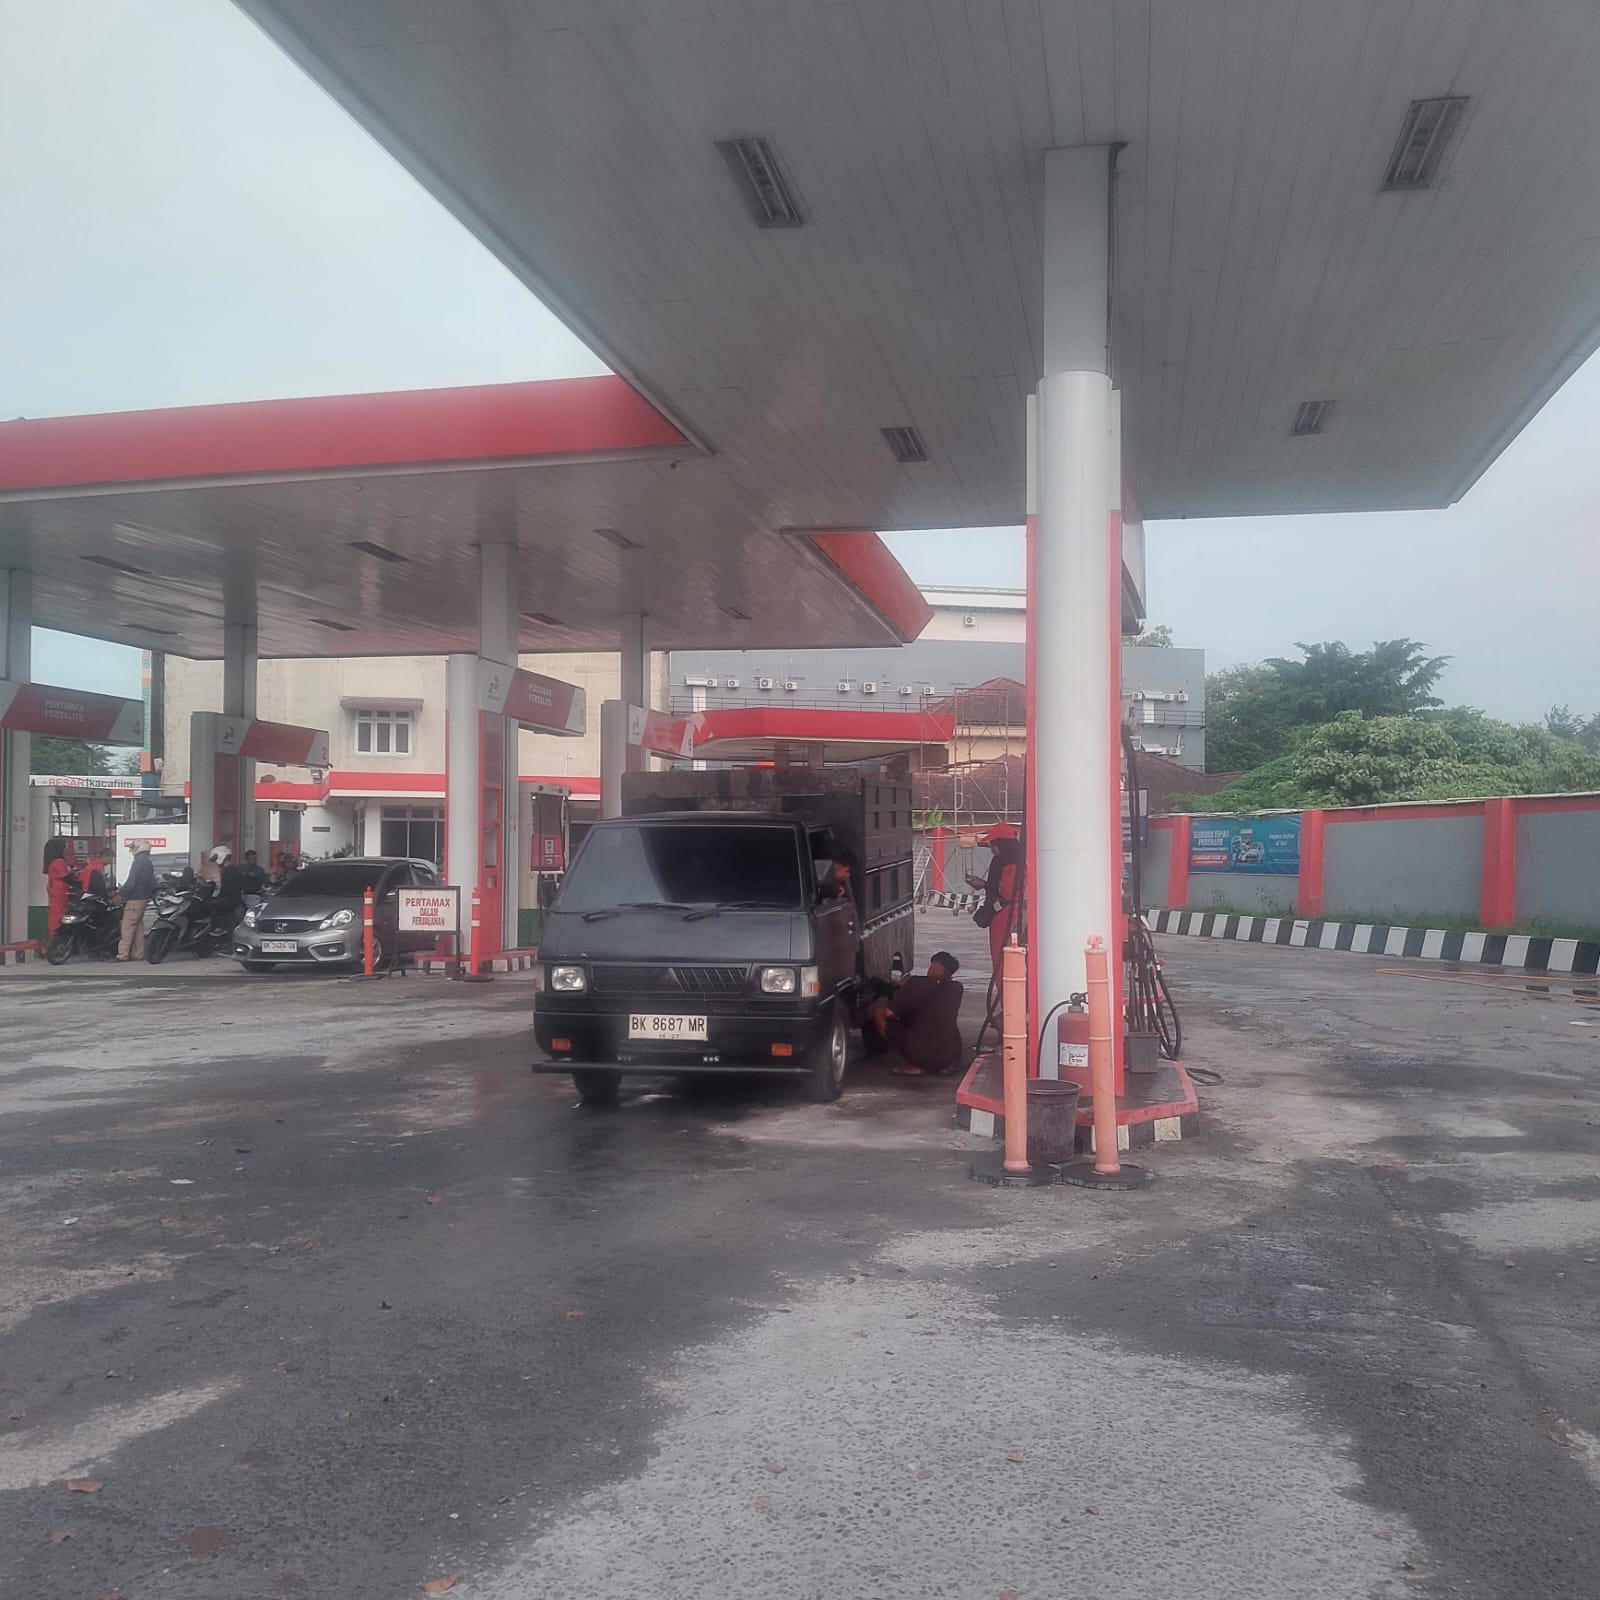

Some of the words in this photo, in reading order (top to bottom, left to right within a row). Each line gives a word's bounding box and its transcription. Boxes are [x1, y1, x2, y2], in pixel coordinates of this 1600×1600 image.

[48, 778, 85, 788] BESAR
[405, 897, 451, 908] PERTAMAX
[420, 907, 439, 916] DALAM
[412, 916, 446, 926] PERJALANAN
[631, 1017, 646, 1031] BK
[653, 1017, 683, 1031] 8687
[688, 1018, 705, 1032] MR
